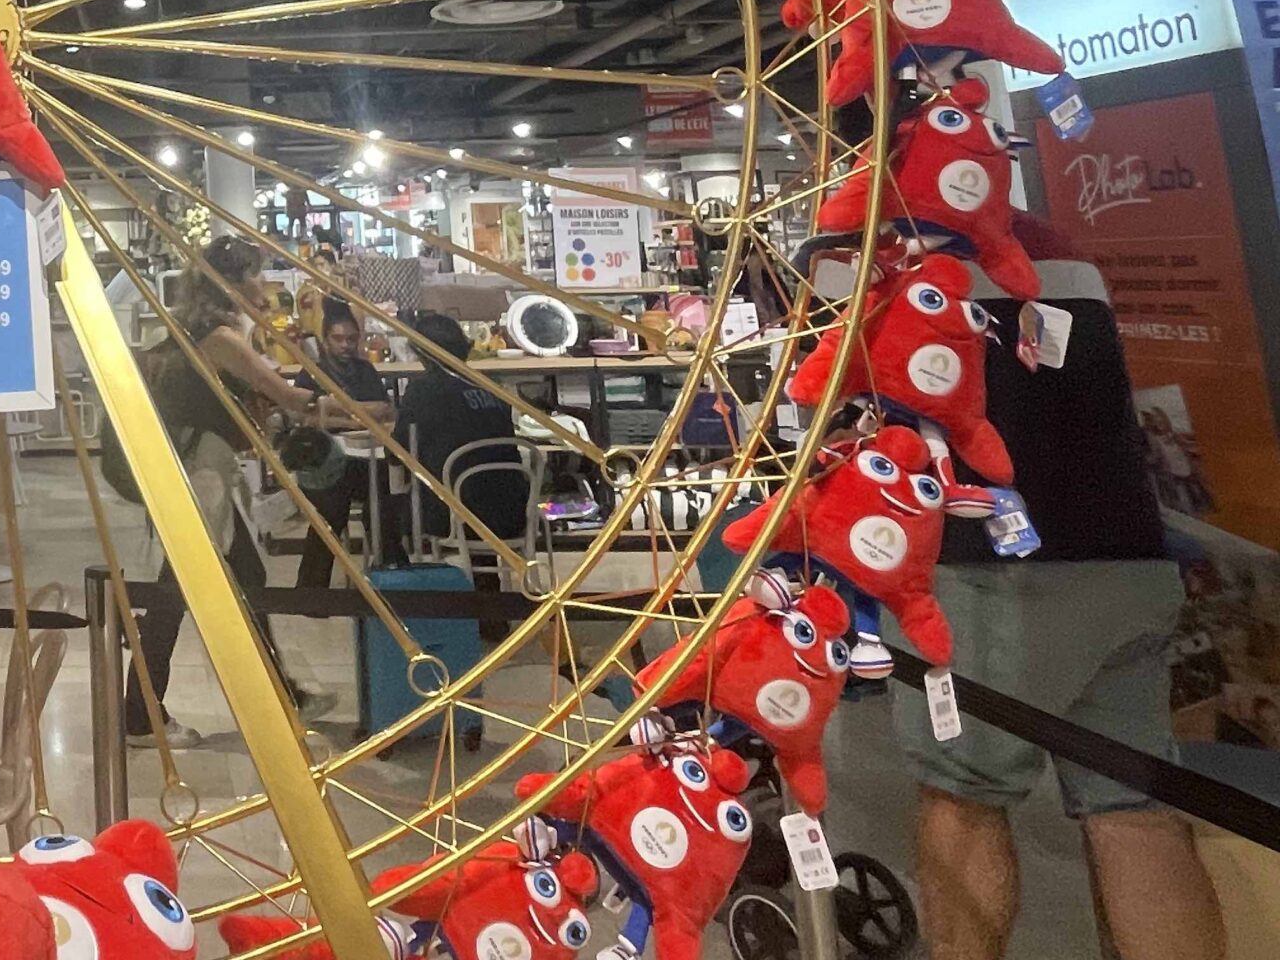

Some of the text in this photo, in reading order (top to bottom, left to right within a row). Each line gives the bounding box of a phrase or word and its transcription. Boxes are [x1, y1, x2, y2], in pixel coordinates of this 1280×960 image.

[1011, 11, 1199, 79] tomaton
[560, 208, 629, 219] MAISON LOISIRS
